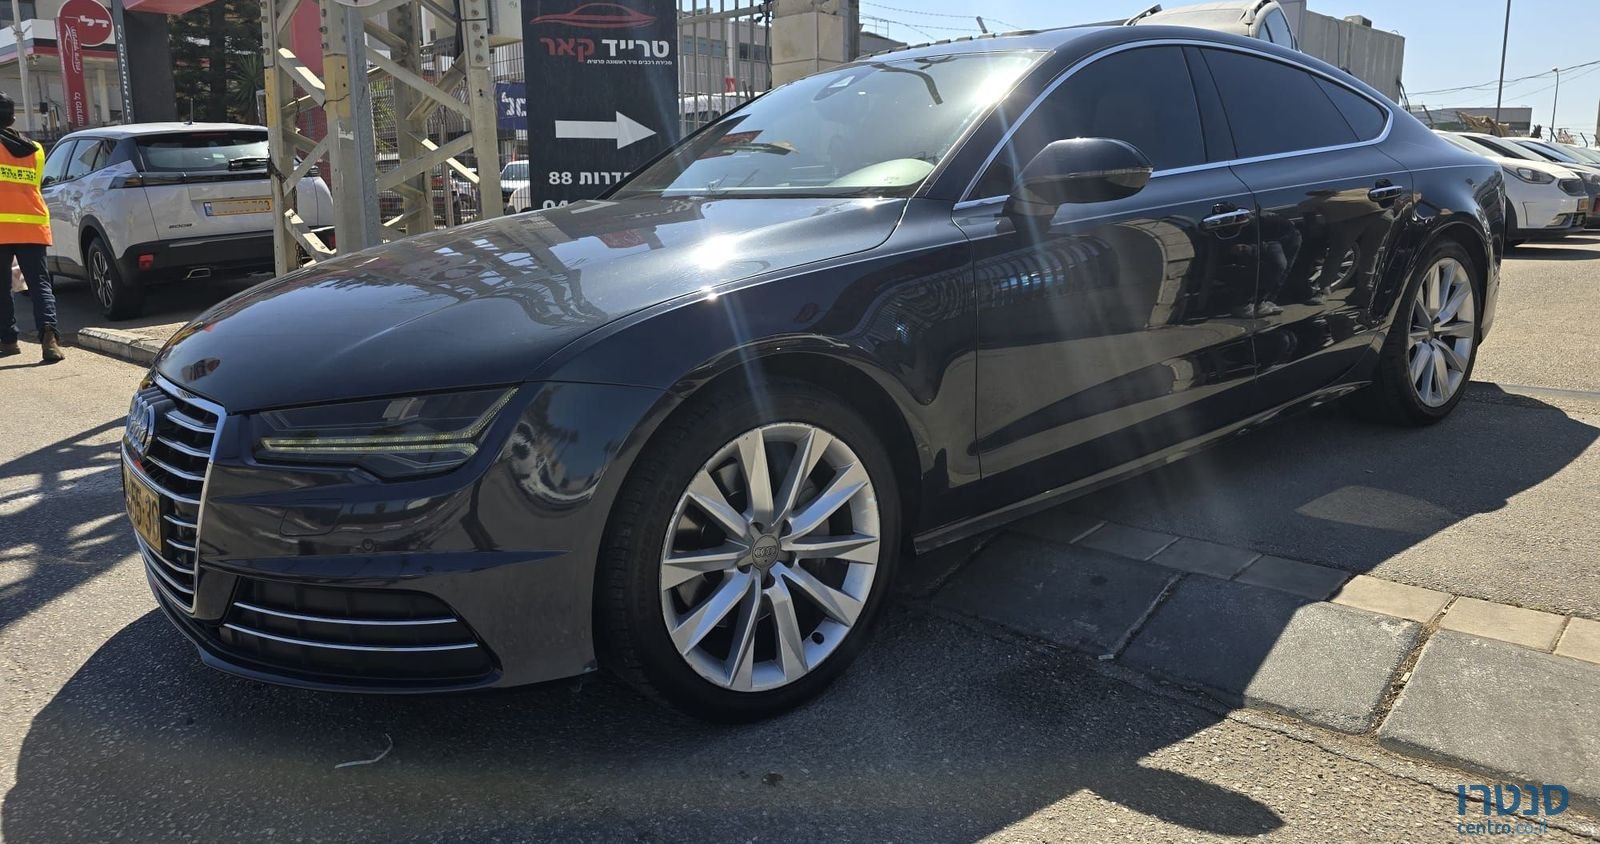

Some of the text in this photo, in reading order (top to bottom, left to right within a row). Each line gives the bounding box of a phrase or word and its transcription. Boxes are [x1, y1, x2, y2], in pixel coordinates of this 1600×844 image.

[539, 37, 670, 63] טרייד קאר
[548, 171, 632, 185] דרות 88
